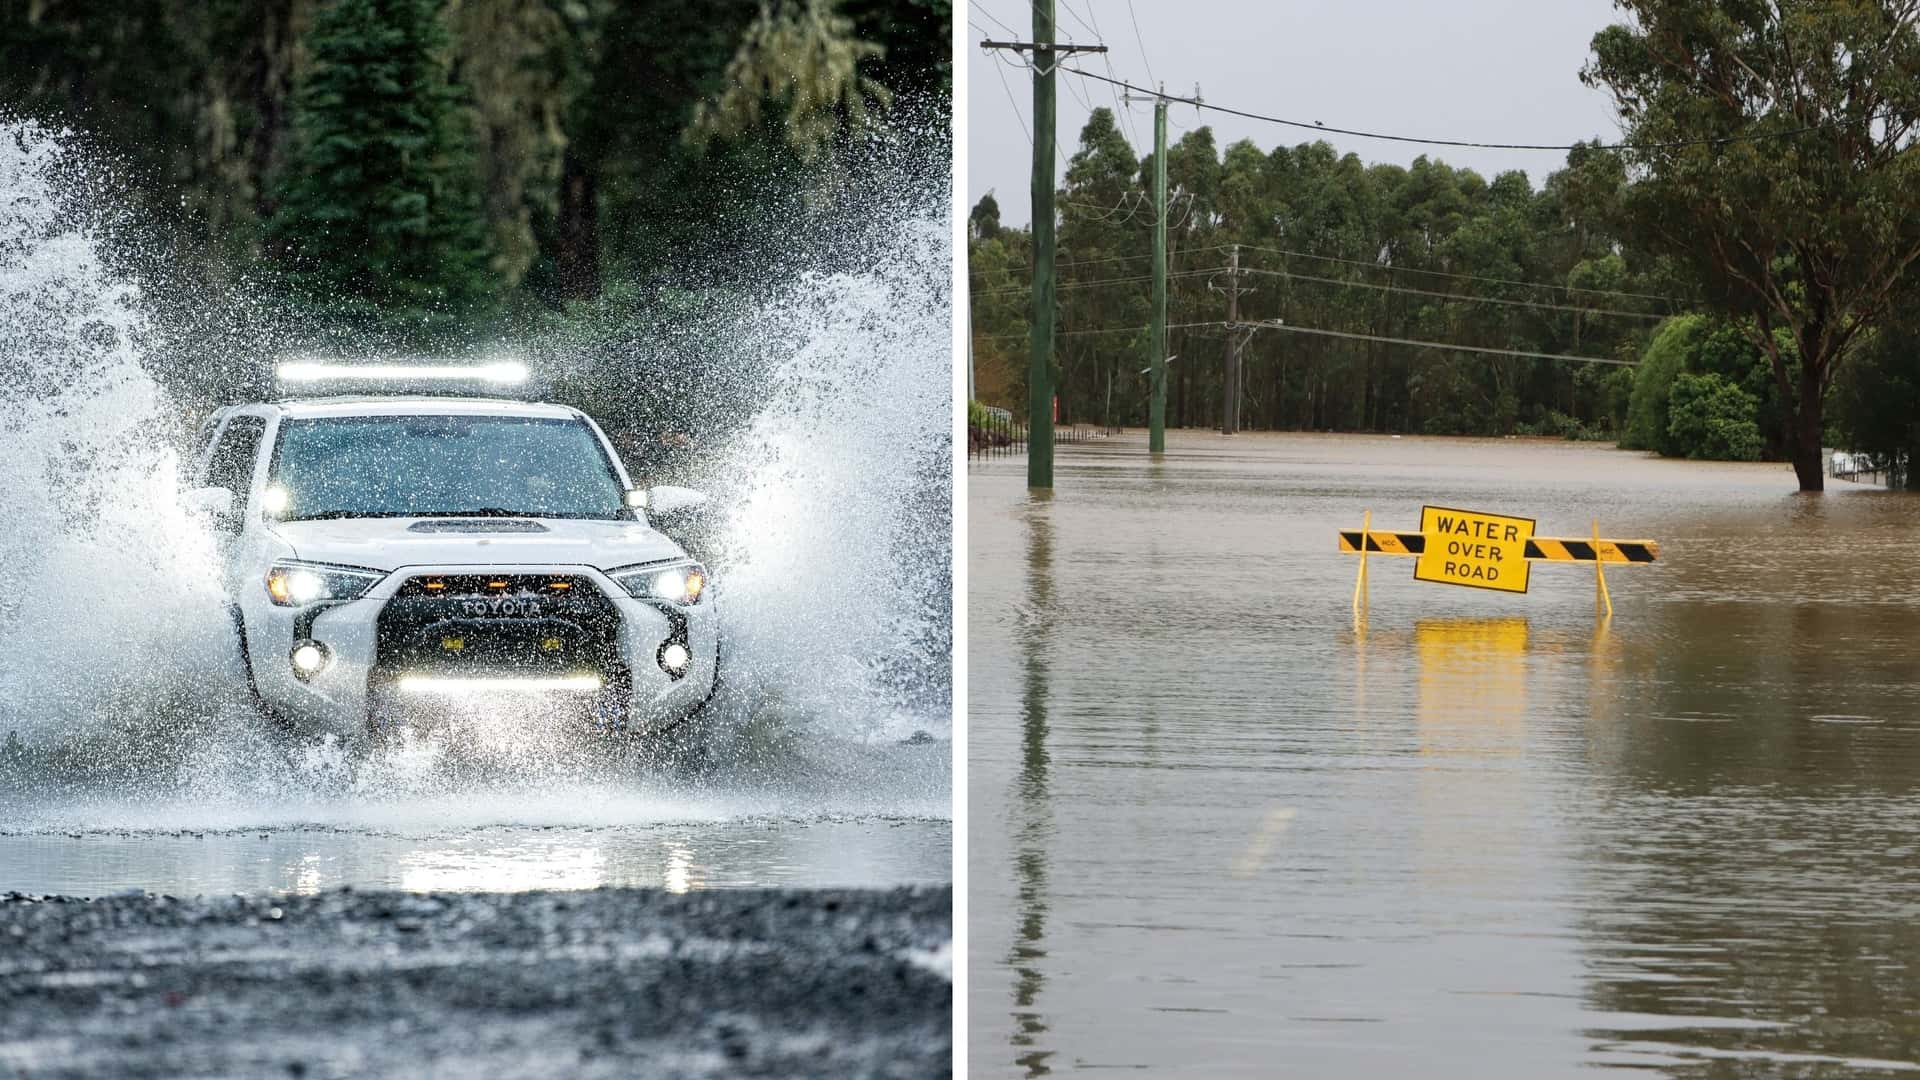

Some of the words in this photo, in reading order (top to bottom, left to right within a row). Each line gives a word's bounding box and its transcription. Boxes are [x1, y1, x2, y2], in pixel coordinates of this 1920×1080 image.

[1437, 515, 1518, 542] WATER
[1448, 541, 1501, 561] OVER
[1444, 561, 1499, 581] ROAD
[462, 601, 541, 616] TOYOTA
